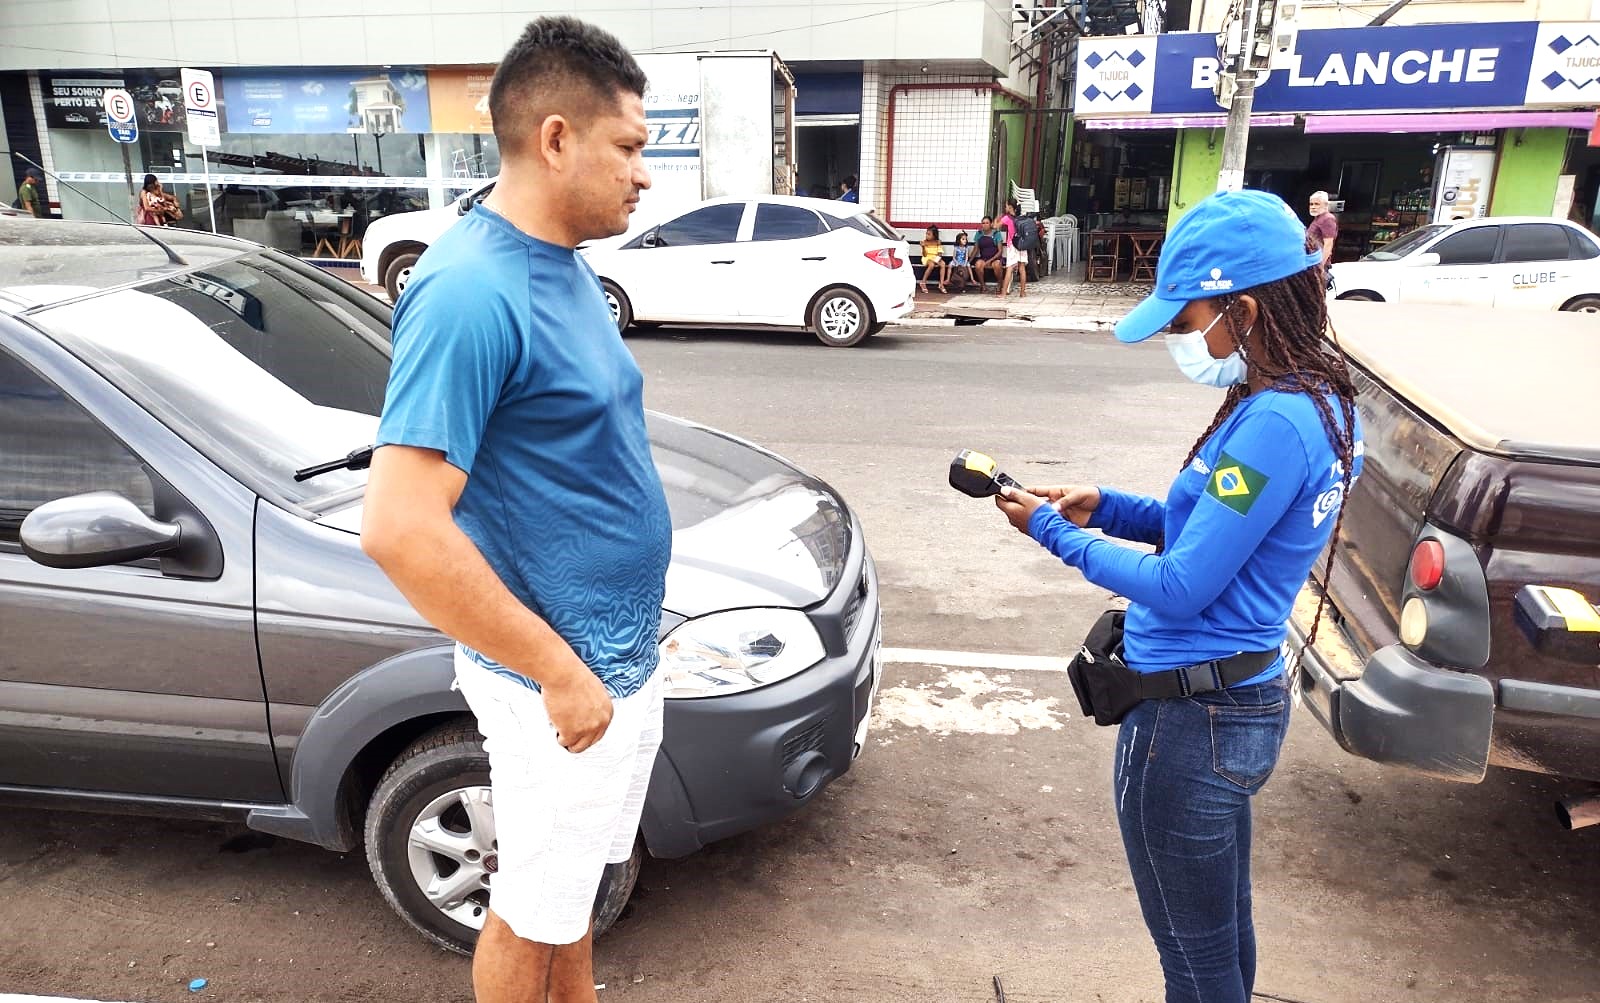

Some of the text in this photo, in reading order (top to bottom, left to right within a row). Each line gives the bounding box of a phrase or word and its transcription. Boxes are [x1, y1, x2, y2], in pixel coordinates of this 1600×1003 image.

[1288, 47, 1500, 87] LANCHE
[1098, 70, 1129, 81] TIJUCA
[52, 87, 70, 96] SEU
[71, 87, 103, 97] SONHO
[194, 87, 205, 102] E
[54, 97, 83, 107] PERTO
[84, 98, 97, 108] DE
[115, 99, 125, 115] E
[1512, 271, 1557, 285] CLUBE
